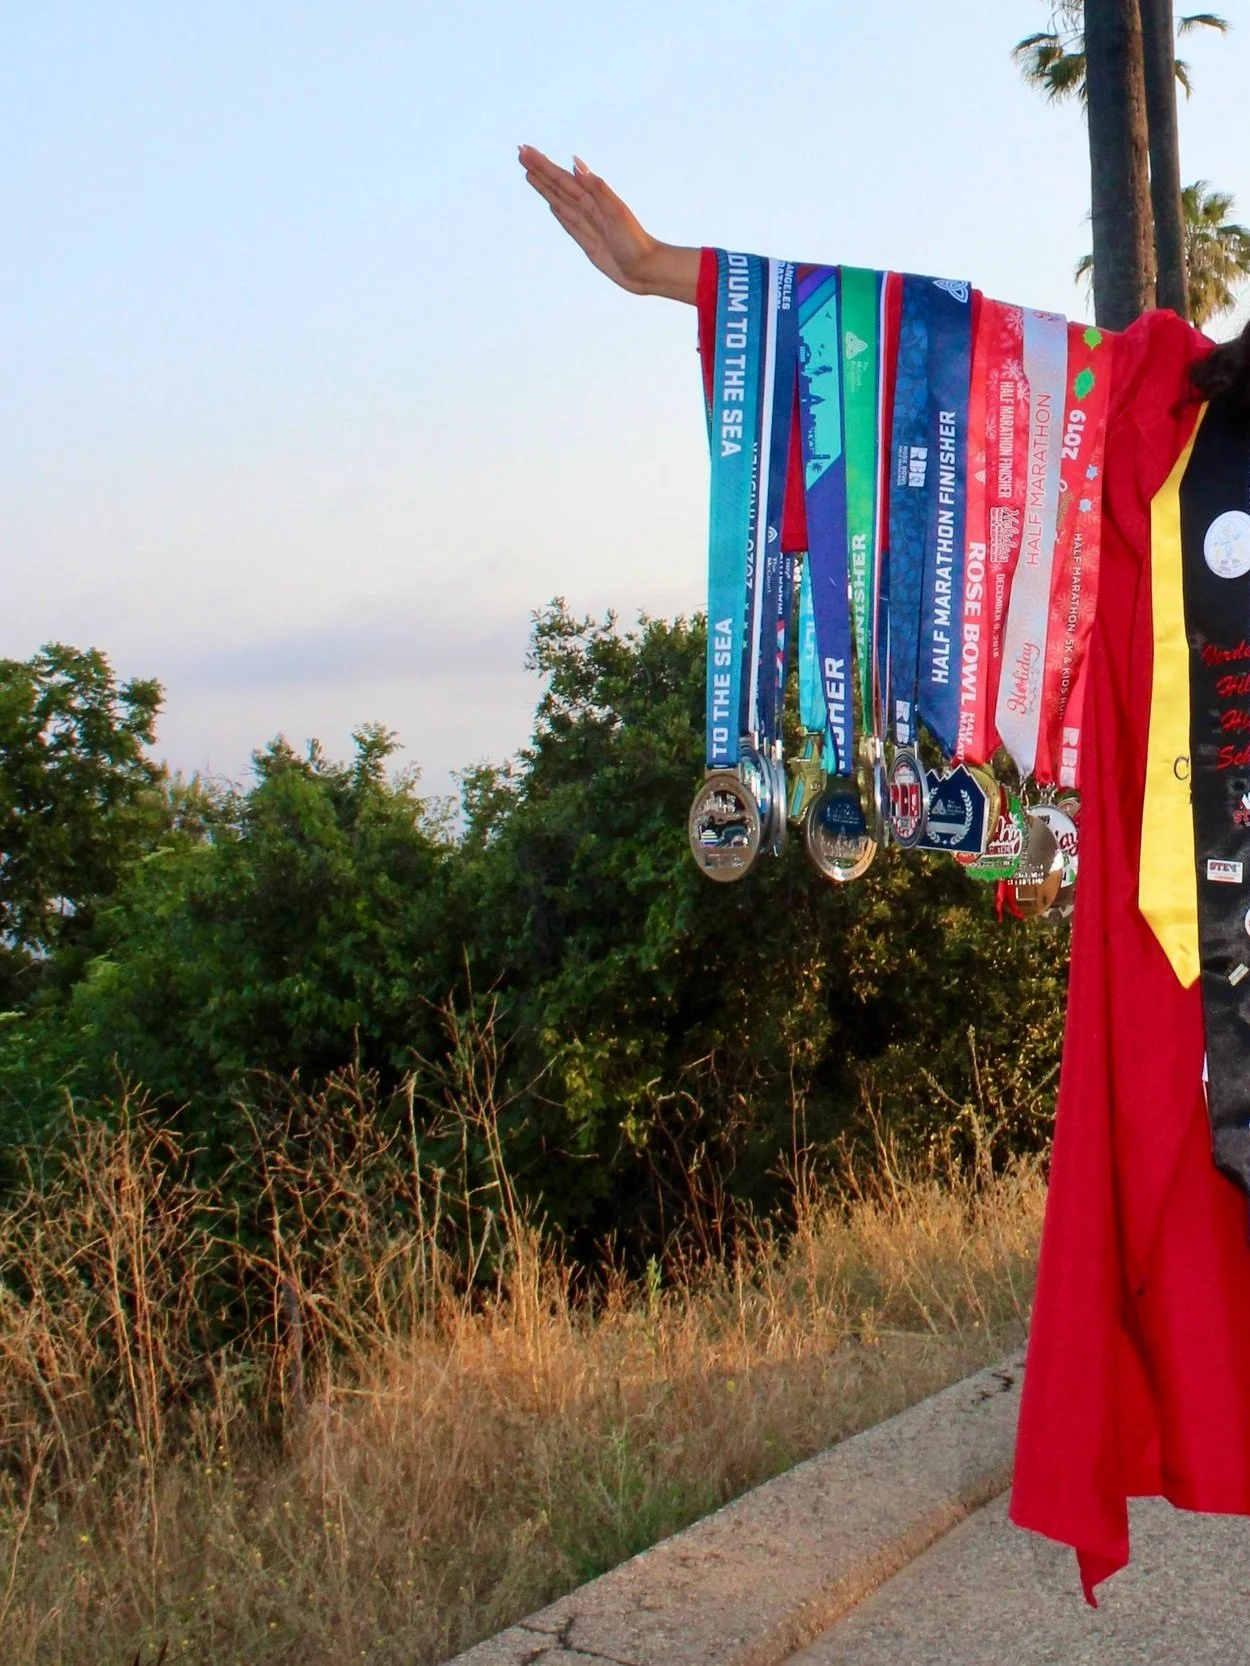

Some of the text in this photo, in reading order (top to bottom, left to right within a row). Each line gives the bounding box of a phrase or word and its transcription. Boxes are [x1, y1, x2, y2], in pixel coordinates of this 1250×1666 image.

[782, 263, 795, 310] ANGELES
[726, 318, 748, 349] TO
[722, 354, 746, 402] THE
[720, 409, 744, 458] SEA
[997, 381, 1015, 498] HALF MARATHON FINISHER
[1060, 409, 1087, 461] 2019
[1026, 393, 1052, 566] HALF MARATHON
[932, 411, 957, 684] HALF MARATHON FINISHER
[1072, 532, 1083, 564] HALF
[993, 573, 1006, 622] DECEMBER
[961, 541, 987, 707] ROSE BOWL
[1064, 639, 1074, 653] 5K
[712, 617, 733, 759] TO THE SEA
[1006, 642, 1041, 715] Holiday
[1061, 667, 1070, 694] KIDS
[966, 712, 976, 746] HALF
